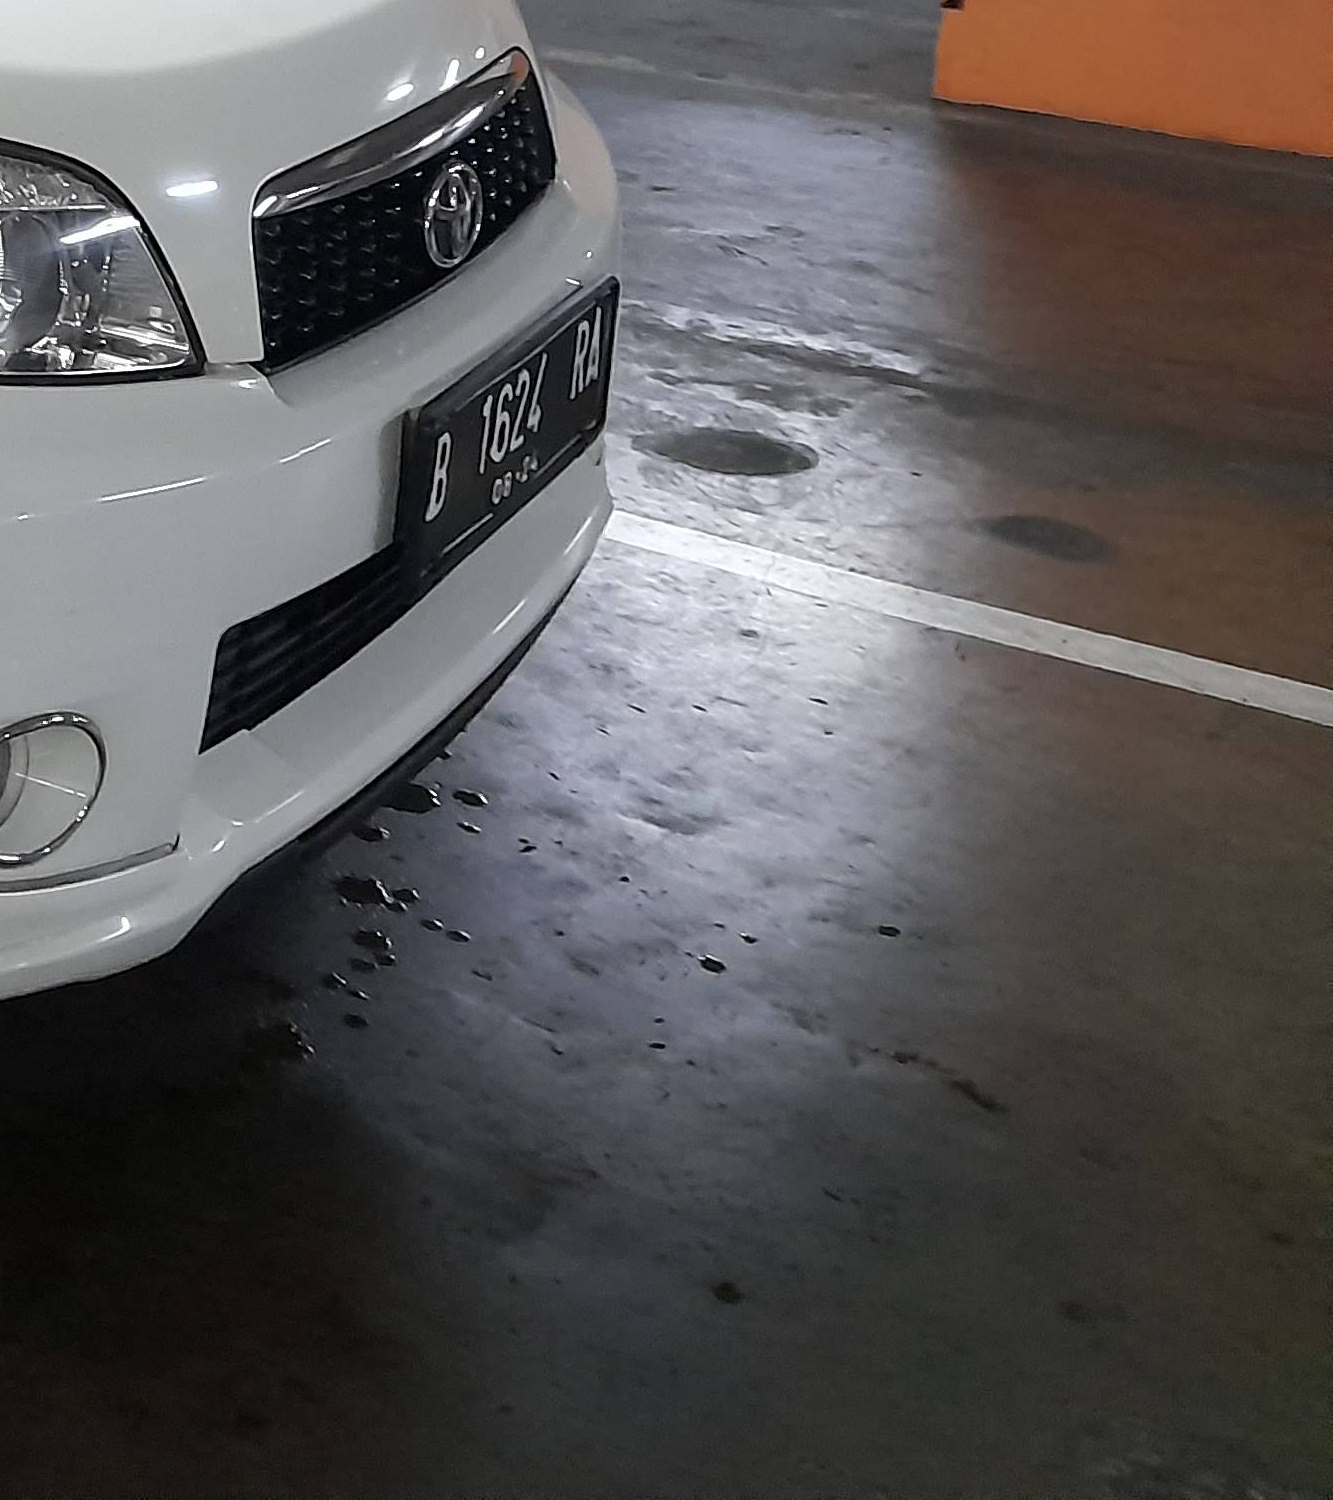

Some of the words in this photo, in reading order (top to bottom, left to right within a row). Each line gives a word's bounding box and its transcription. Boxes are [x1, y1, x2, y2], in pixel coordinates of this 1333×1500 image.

[425, 431, 453, 522] B
[479, 351, 548, 475] 1624
[568, 306, 602, 400] RA
